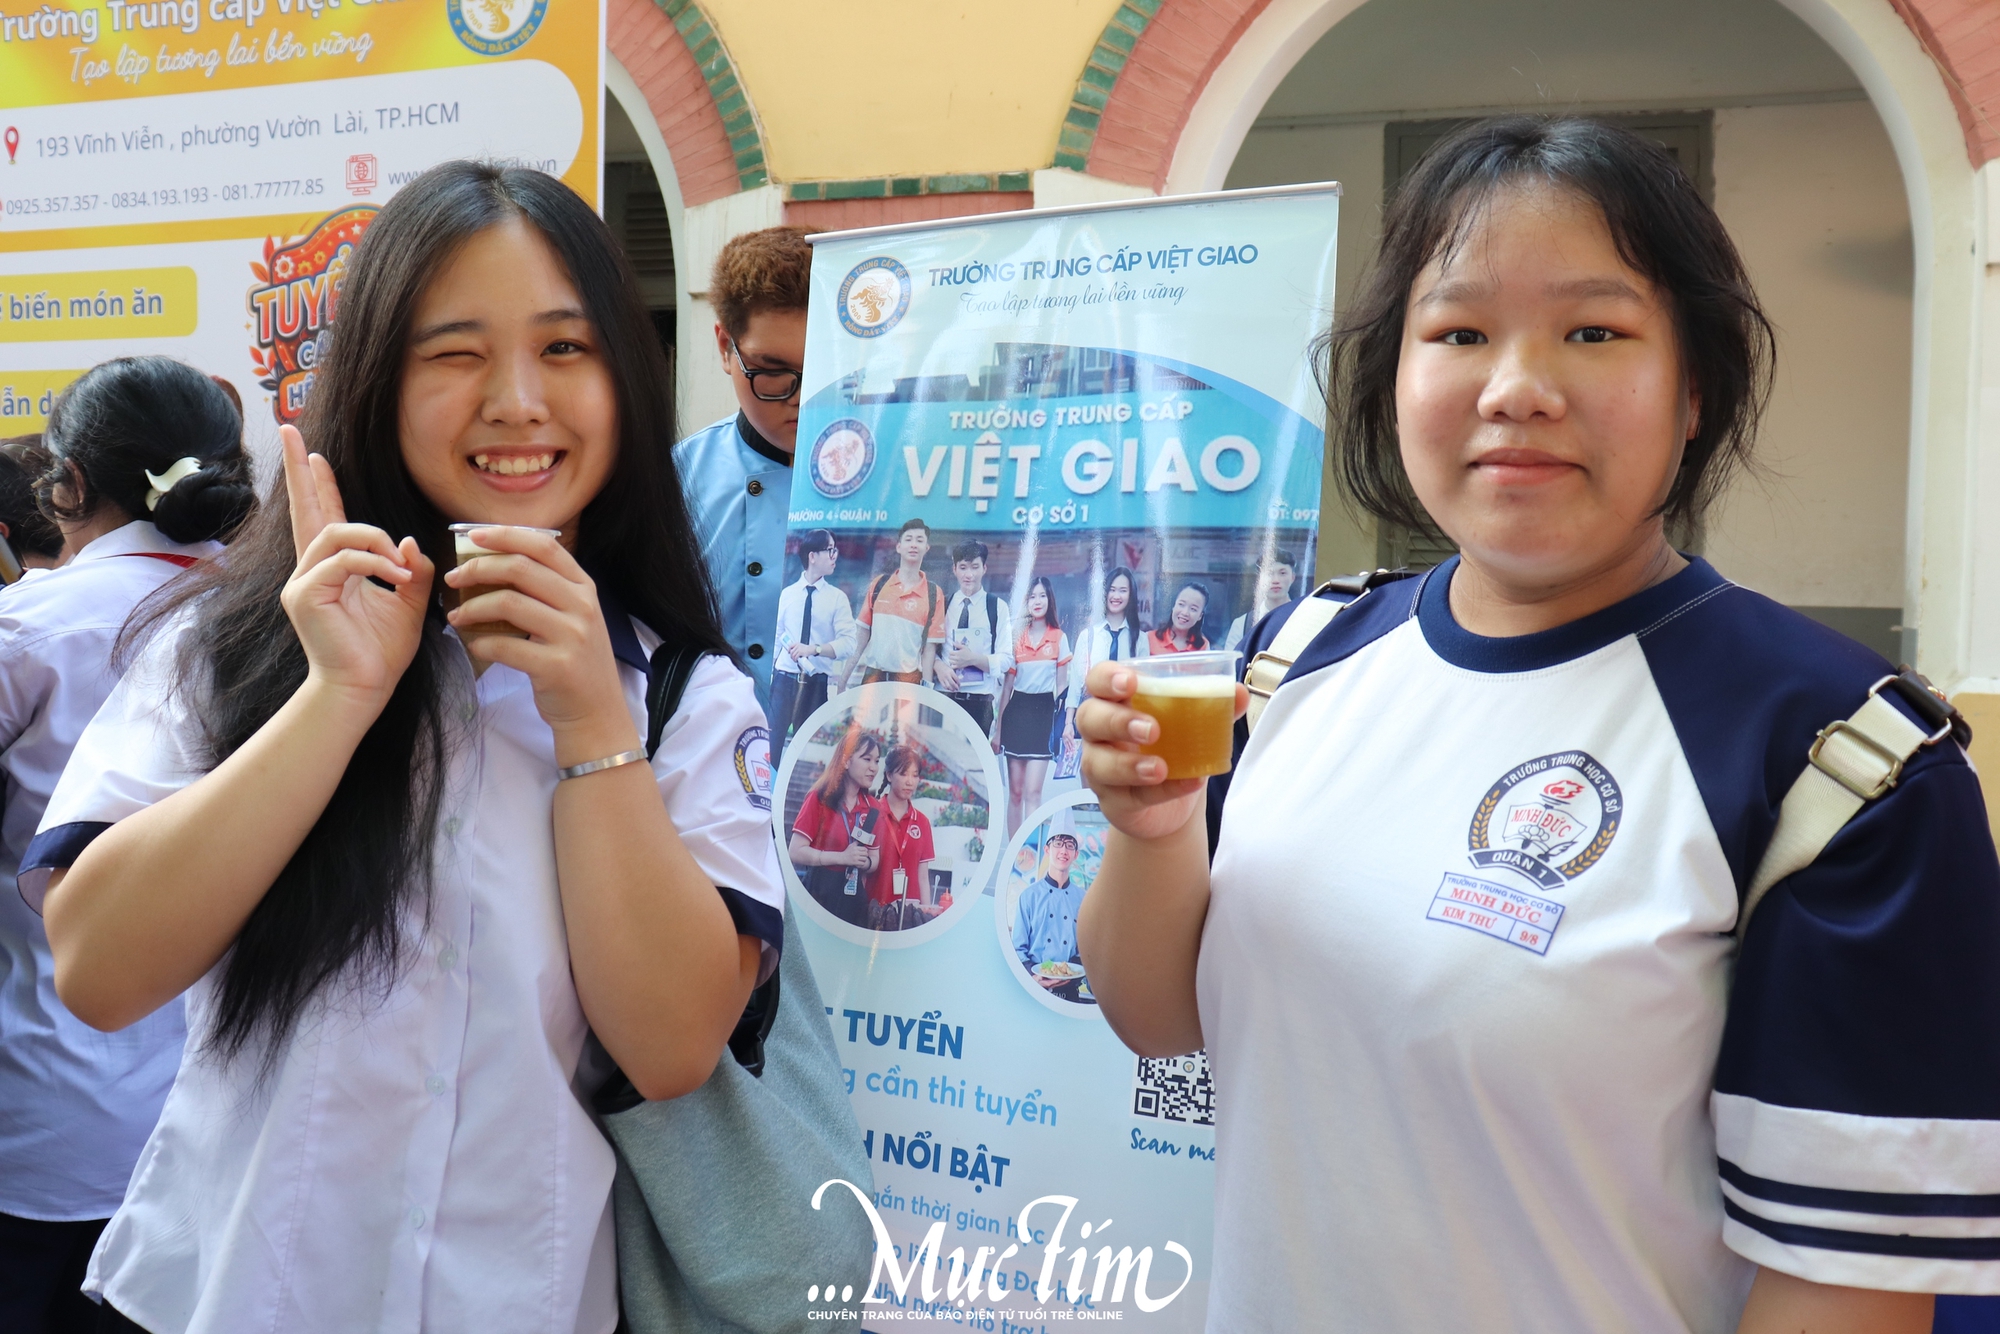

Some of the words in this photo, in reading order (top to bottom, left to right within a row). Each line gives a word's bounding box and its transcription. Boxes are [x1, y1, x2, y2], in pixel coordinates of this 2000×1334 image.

[0, 5, 99, 43] rường
[106, 0, 200, 33] Trung
[69, 46, 110, 86] Tạo
[115, 43, 149, 85] lập
[226, 32, 259, 66] lai
[36, 136, 68, 157] 193
[74, 132, 116, 155] Vĩnh
[122, 126, 163, 150] Viễn
[181, 122, 260, 153] phường
[266, 115, 320, 139] Vườn
[334, 111, 368, 134] Lài,
[376, 102, 460, 130] TP.HCM
[6, 194, 99, 215] 0925.357.357
[111, 187, 208, 208] 0834.193.193
[222, 178, 324, 201] 081.77777.85
[929, 261, 1016, 287] TRƯỜNG
[1021, 256, 1092, 281] TRUNG
[1095, 245, 1142, 273] CẤP
[1147, 244, 1193, 274] VIỆT
[1197, 243, 1259, 267] GIAO
[10, 292, 61, 320] biến
[69, 290, 124, 317] món
[132, 288, 163, 315] ăn
[850, 303, 862, 320] 2000
[949, 404, 1046, 430] TRƯỜNG
[1056, 403, 1132, 426] TRUNG
[1139, 395, 1194, 421] CẤP
[904, 430, 1041, 513] VIỆT
[1061, 434, 1262, 496] GIAO
[875, 509, 888, 521] 10
[1049, 499, 1077, 524] SỞ
[1082, 505, 1090, 523] 1
[1503, 760, 1548, 788] TRƯỜNG
[1551, 754, 1585, 768] TRUNG
[1584, 763, 1607, 785] HỌC
[1601, 785, 1616, 799] CƠ
[1511, 808, 1541, 823] MINH
[1541, 812, 1572, 838] ĐỨC
[1492, 852, 1535, 871] QUẬN
[1537, 869, 1547, 879] 1
[1447, 876, 1478, 889] TRƯỜNG
[1479, 884, 1508, 898] TRUNG
[1509, 893, 1529, 905] HỌC
[1450, 888, 1497, 909] MINH
[1500, 904, 1542, 924] ĐỨC
[1442, 906, 1464, 920] KIM
[1467, 911, 1498, 930] THƯ
[1519, 931, 1539, 946] 9/8
[843, 1010, 964, 1060] TUYỂN
[866, 1065, 919, 1100] cần
[928, 1075, 967, 1109] thi
[974, 1085, 1058, 1127] tuyển
[1131, 1127, 1181, 1156] Scan
[882, 1131, 942, 1174] NỔI
[949, 1143, 1011, 1194] BẬT
[911, 1195, 951, 1222] thời
[956, 1208, 1000, 1231] gian
